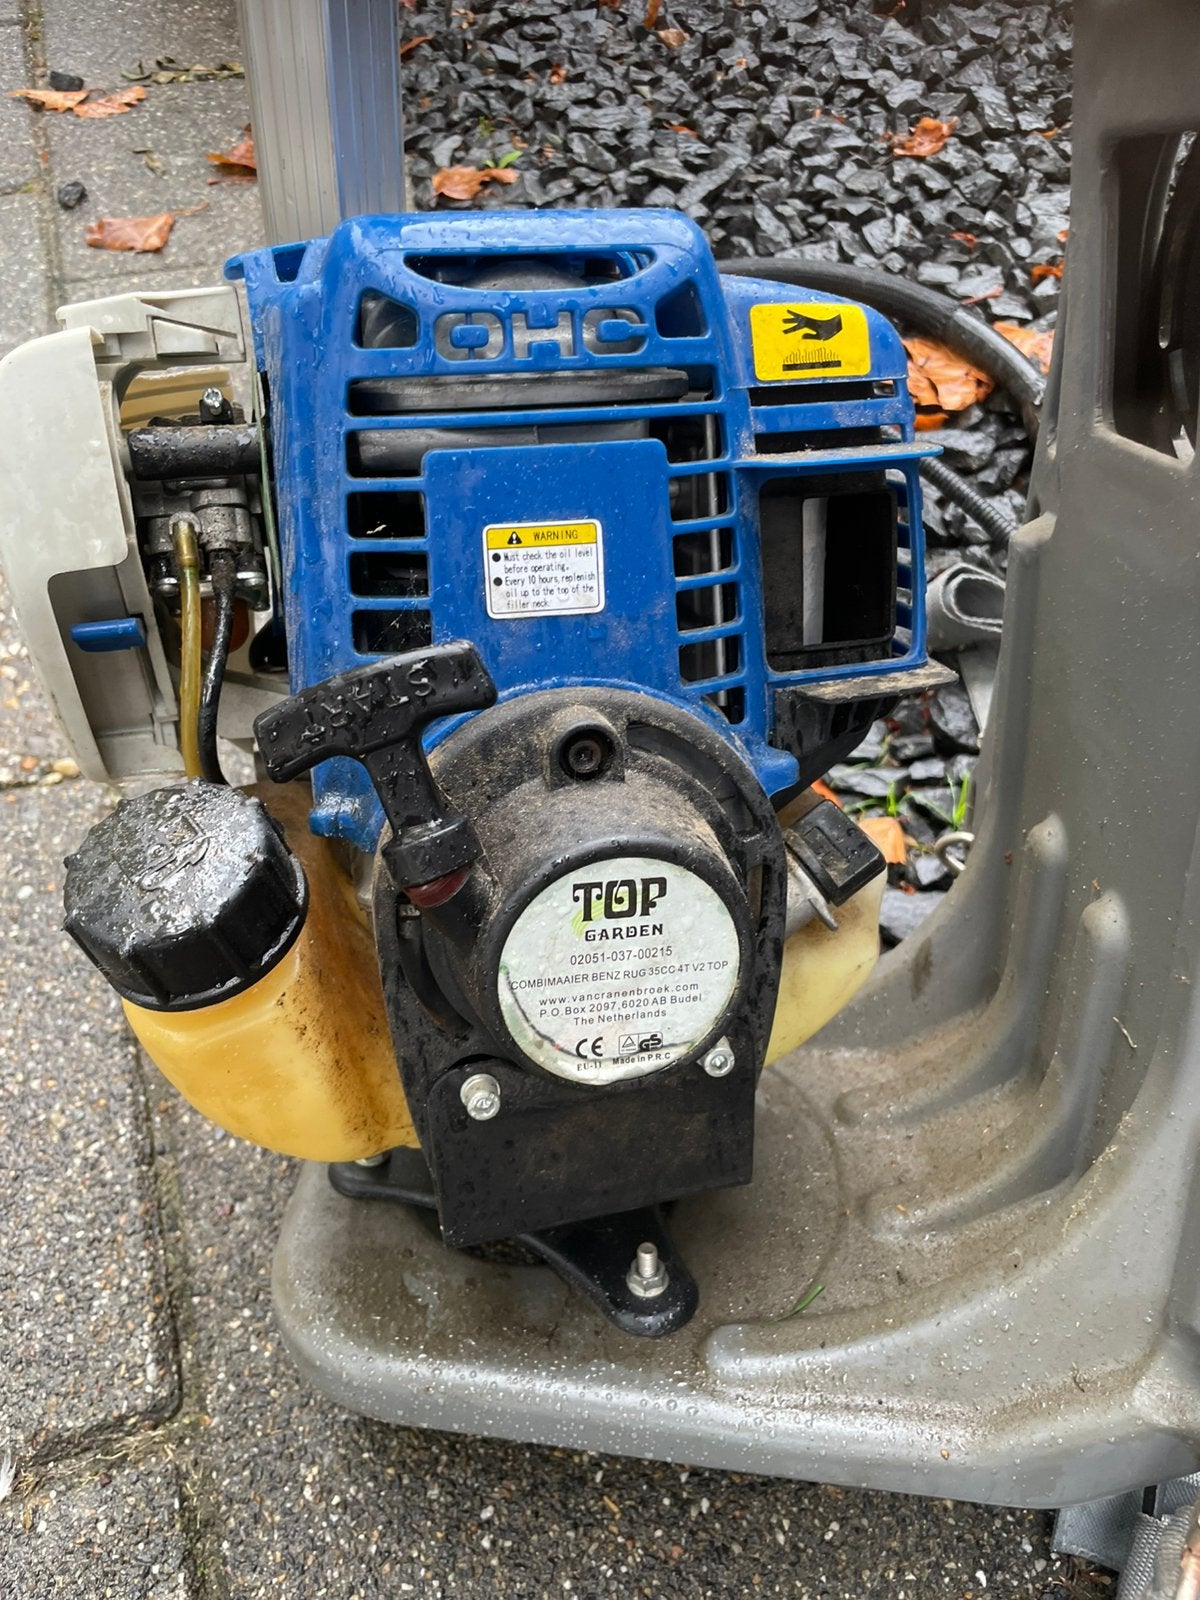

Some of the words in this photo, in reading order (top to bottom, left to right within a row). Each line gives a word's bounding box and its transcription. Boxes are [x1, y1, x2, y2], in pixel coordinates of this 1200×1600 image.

[434, 308, 649, 361] OHC
[533, 530, 579, 541] WARNING
[503, 552, 520, 562] Must
[522, 550, 542, 560] check
[545, 550, 557, 559] the
[559, 549, 571, 559] oil
[575, 547, 593, 557] level
[504, 564, 528, 574] before
[531, 563, 570, 574] operating.
[505, 576, 525, 587] Every
[528, 575, 536, 585] 10
[562, 571, 596, 583] replenish
[505, 589, 517, 598] oil
[520, 589, 529, 599] up
[532, 588, 540, 597] to
[543, 586, 555, 596] the
[557, 586, 569, 595] top
[572, 584, 579, 593] of
[582, 583, 594, 593] the
[506, 600, 529, 609] filler
[299, 658, 434, 743] START
[572, 877, 667, 922] TOP
[585, 923, 664, 942] GARDEN
[570, 946, 673, 966] 02051-037-00215
[510, 973, 589, 991] COMBIMAAIER
[592, 970, 621, 981] BENZ
[623, 968, 646, 979] RUG
[648, 965, 676, 976] 35CC
[677, 963, 690, 973] 4T
[692, 963, 705, 972] V2
[707, 960, 729, 970] TOP
[539, 983, 699, 1006] www.vancranenbroek.com
[651, 996, 667, 1006] AB
[670, 993, 702, 1004] Budel
[574, 1017, 594, 1026] The
[597, 1009, 667, 1024] Netherlands
[575, 1036, 604, 1059] CE
[612, 1056, 635, 1065] Made
